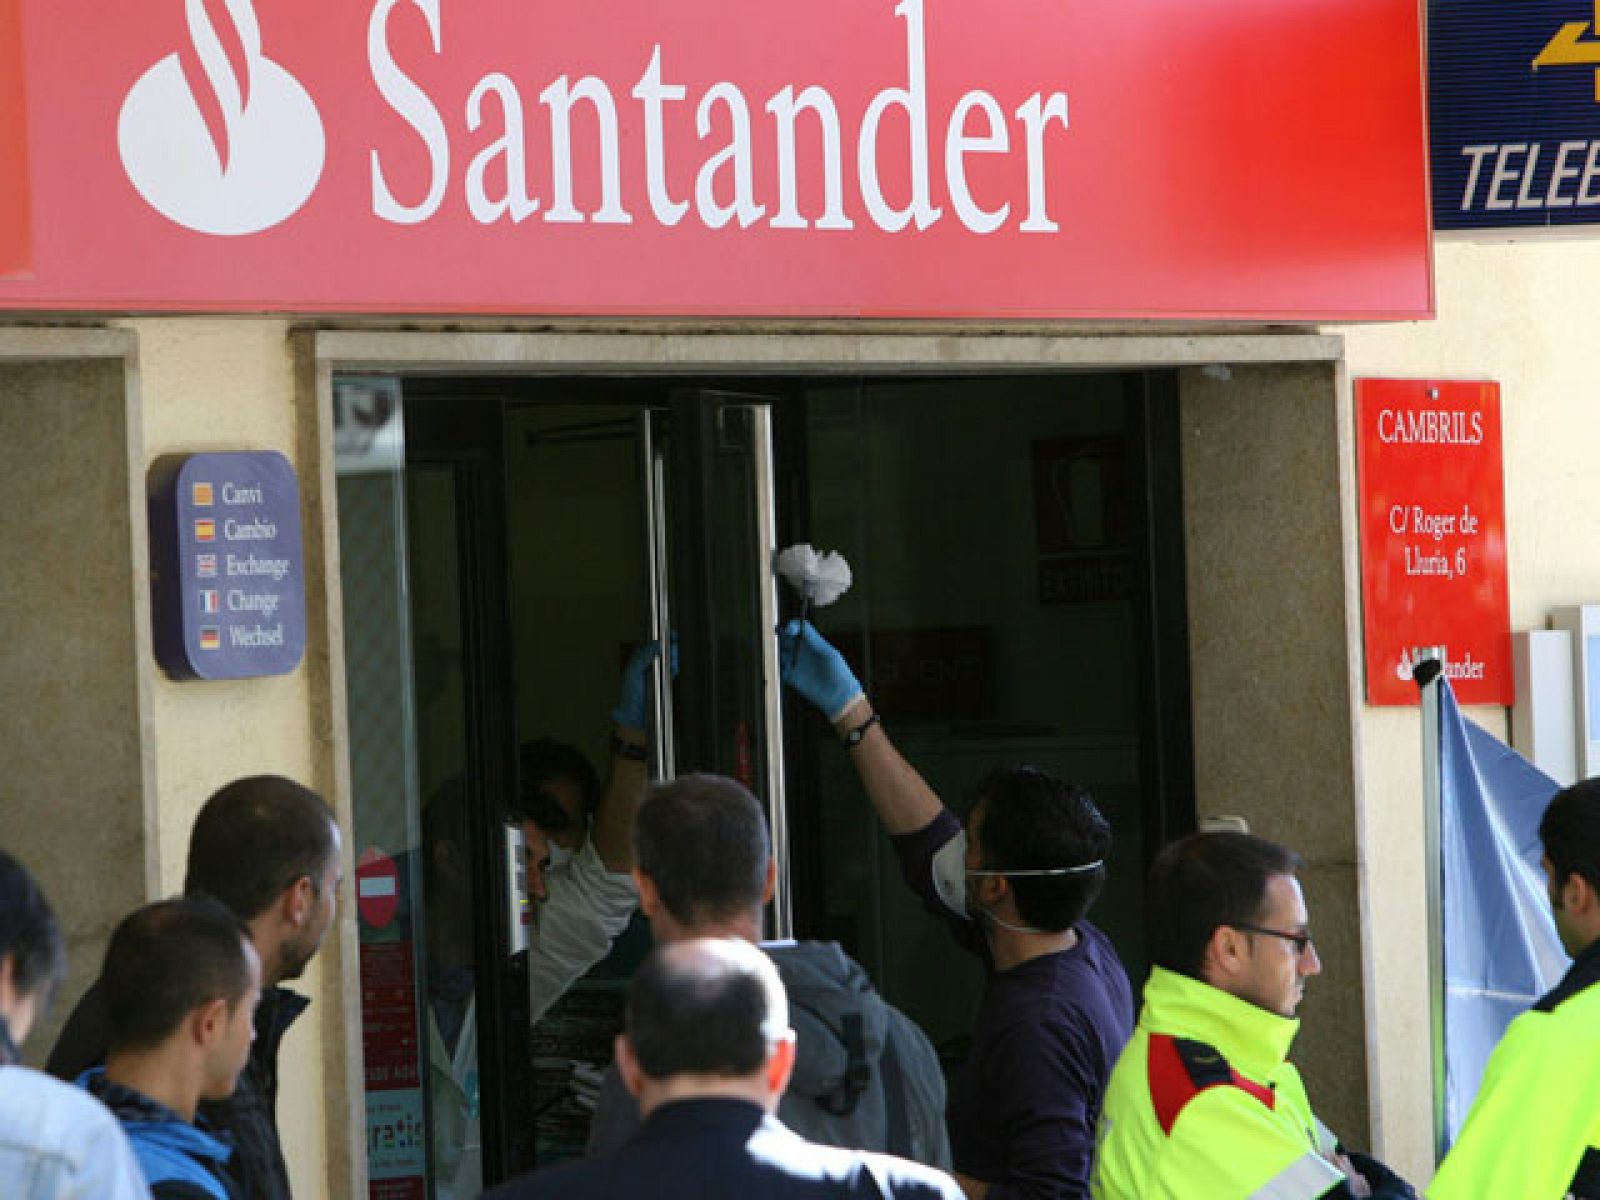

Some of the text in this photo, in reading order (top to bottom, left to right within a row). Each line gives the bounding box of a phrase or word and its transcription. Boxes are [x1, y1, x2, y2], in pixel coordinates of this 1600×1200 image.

[367, 0, 1068, 233] Santander
[1377, 409, 1483, 445] CAMBRILS
[222, 481, 262, 505] Canvi
[224, 517, 277, 541] Cambio
[1389, 505, 1478, 540] C/ Roger de
[226, 552, 291, 581] Exchange
[1455, 546, 1466, 576] 6
[227, 589, 280, 617] Change
[230, 623, 284, 646] Wechsel
[1420, 651, 1485, 680] ander
